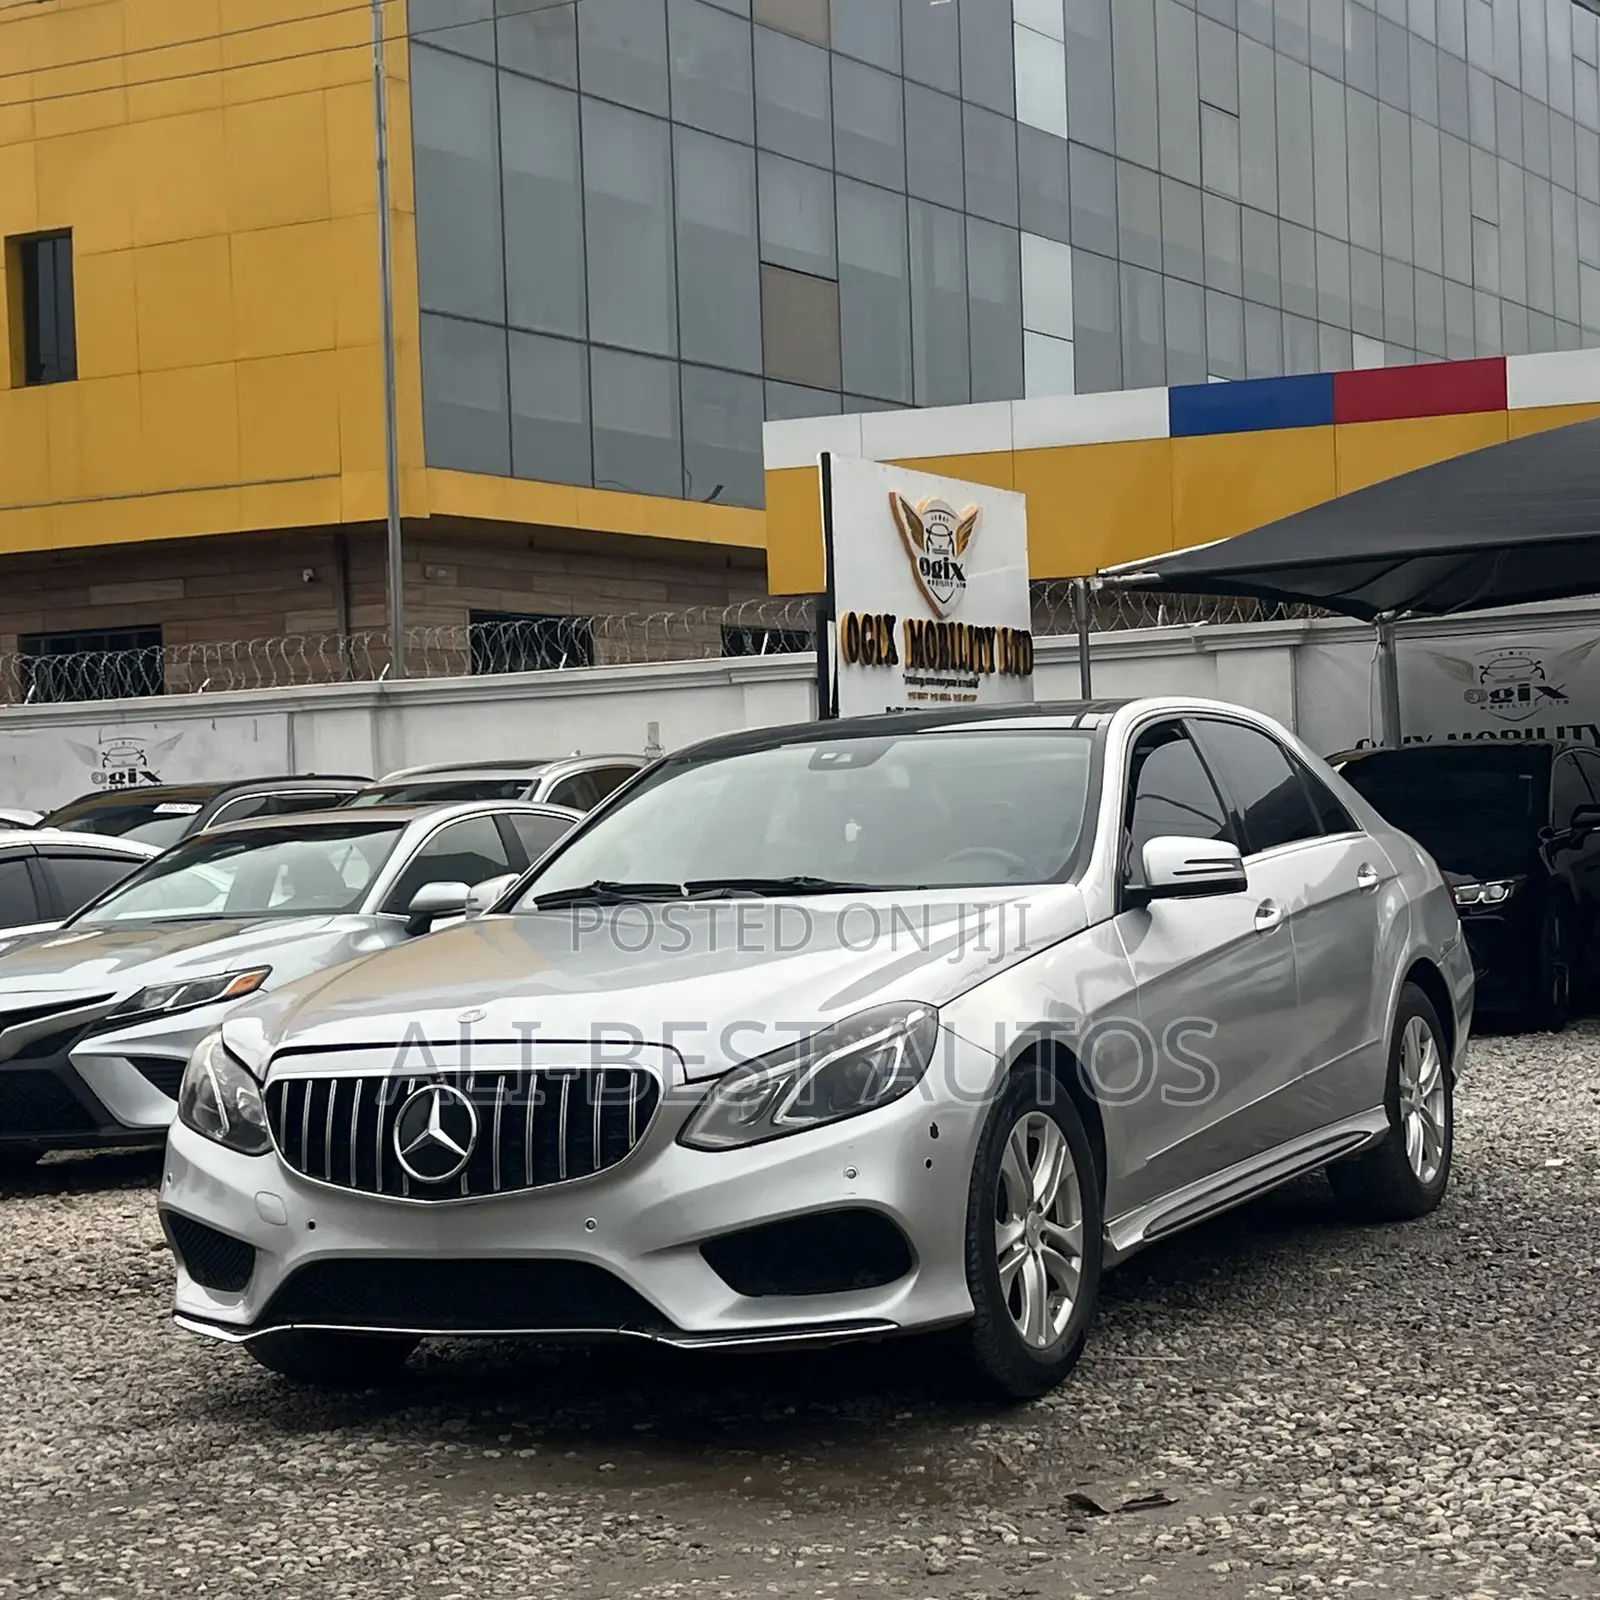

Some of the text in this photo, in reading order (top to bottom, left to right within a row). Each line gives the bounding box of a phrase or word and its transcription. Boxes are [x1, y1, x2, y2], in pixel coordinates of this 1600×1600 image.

[841, 611, 1034, 676] OGIX MOBILITY LTD
